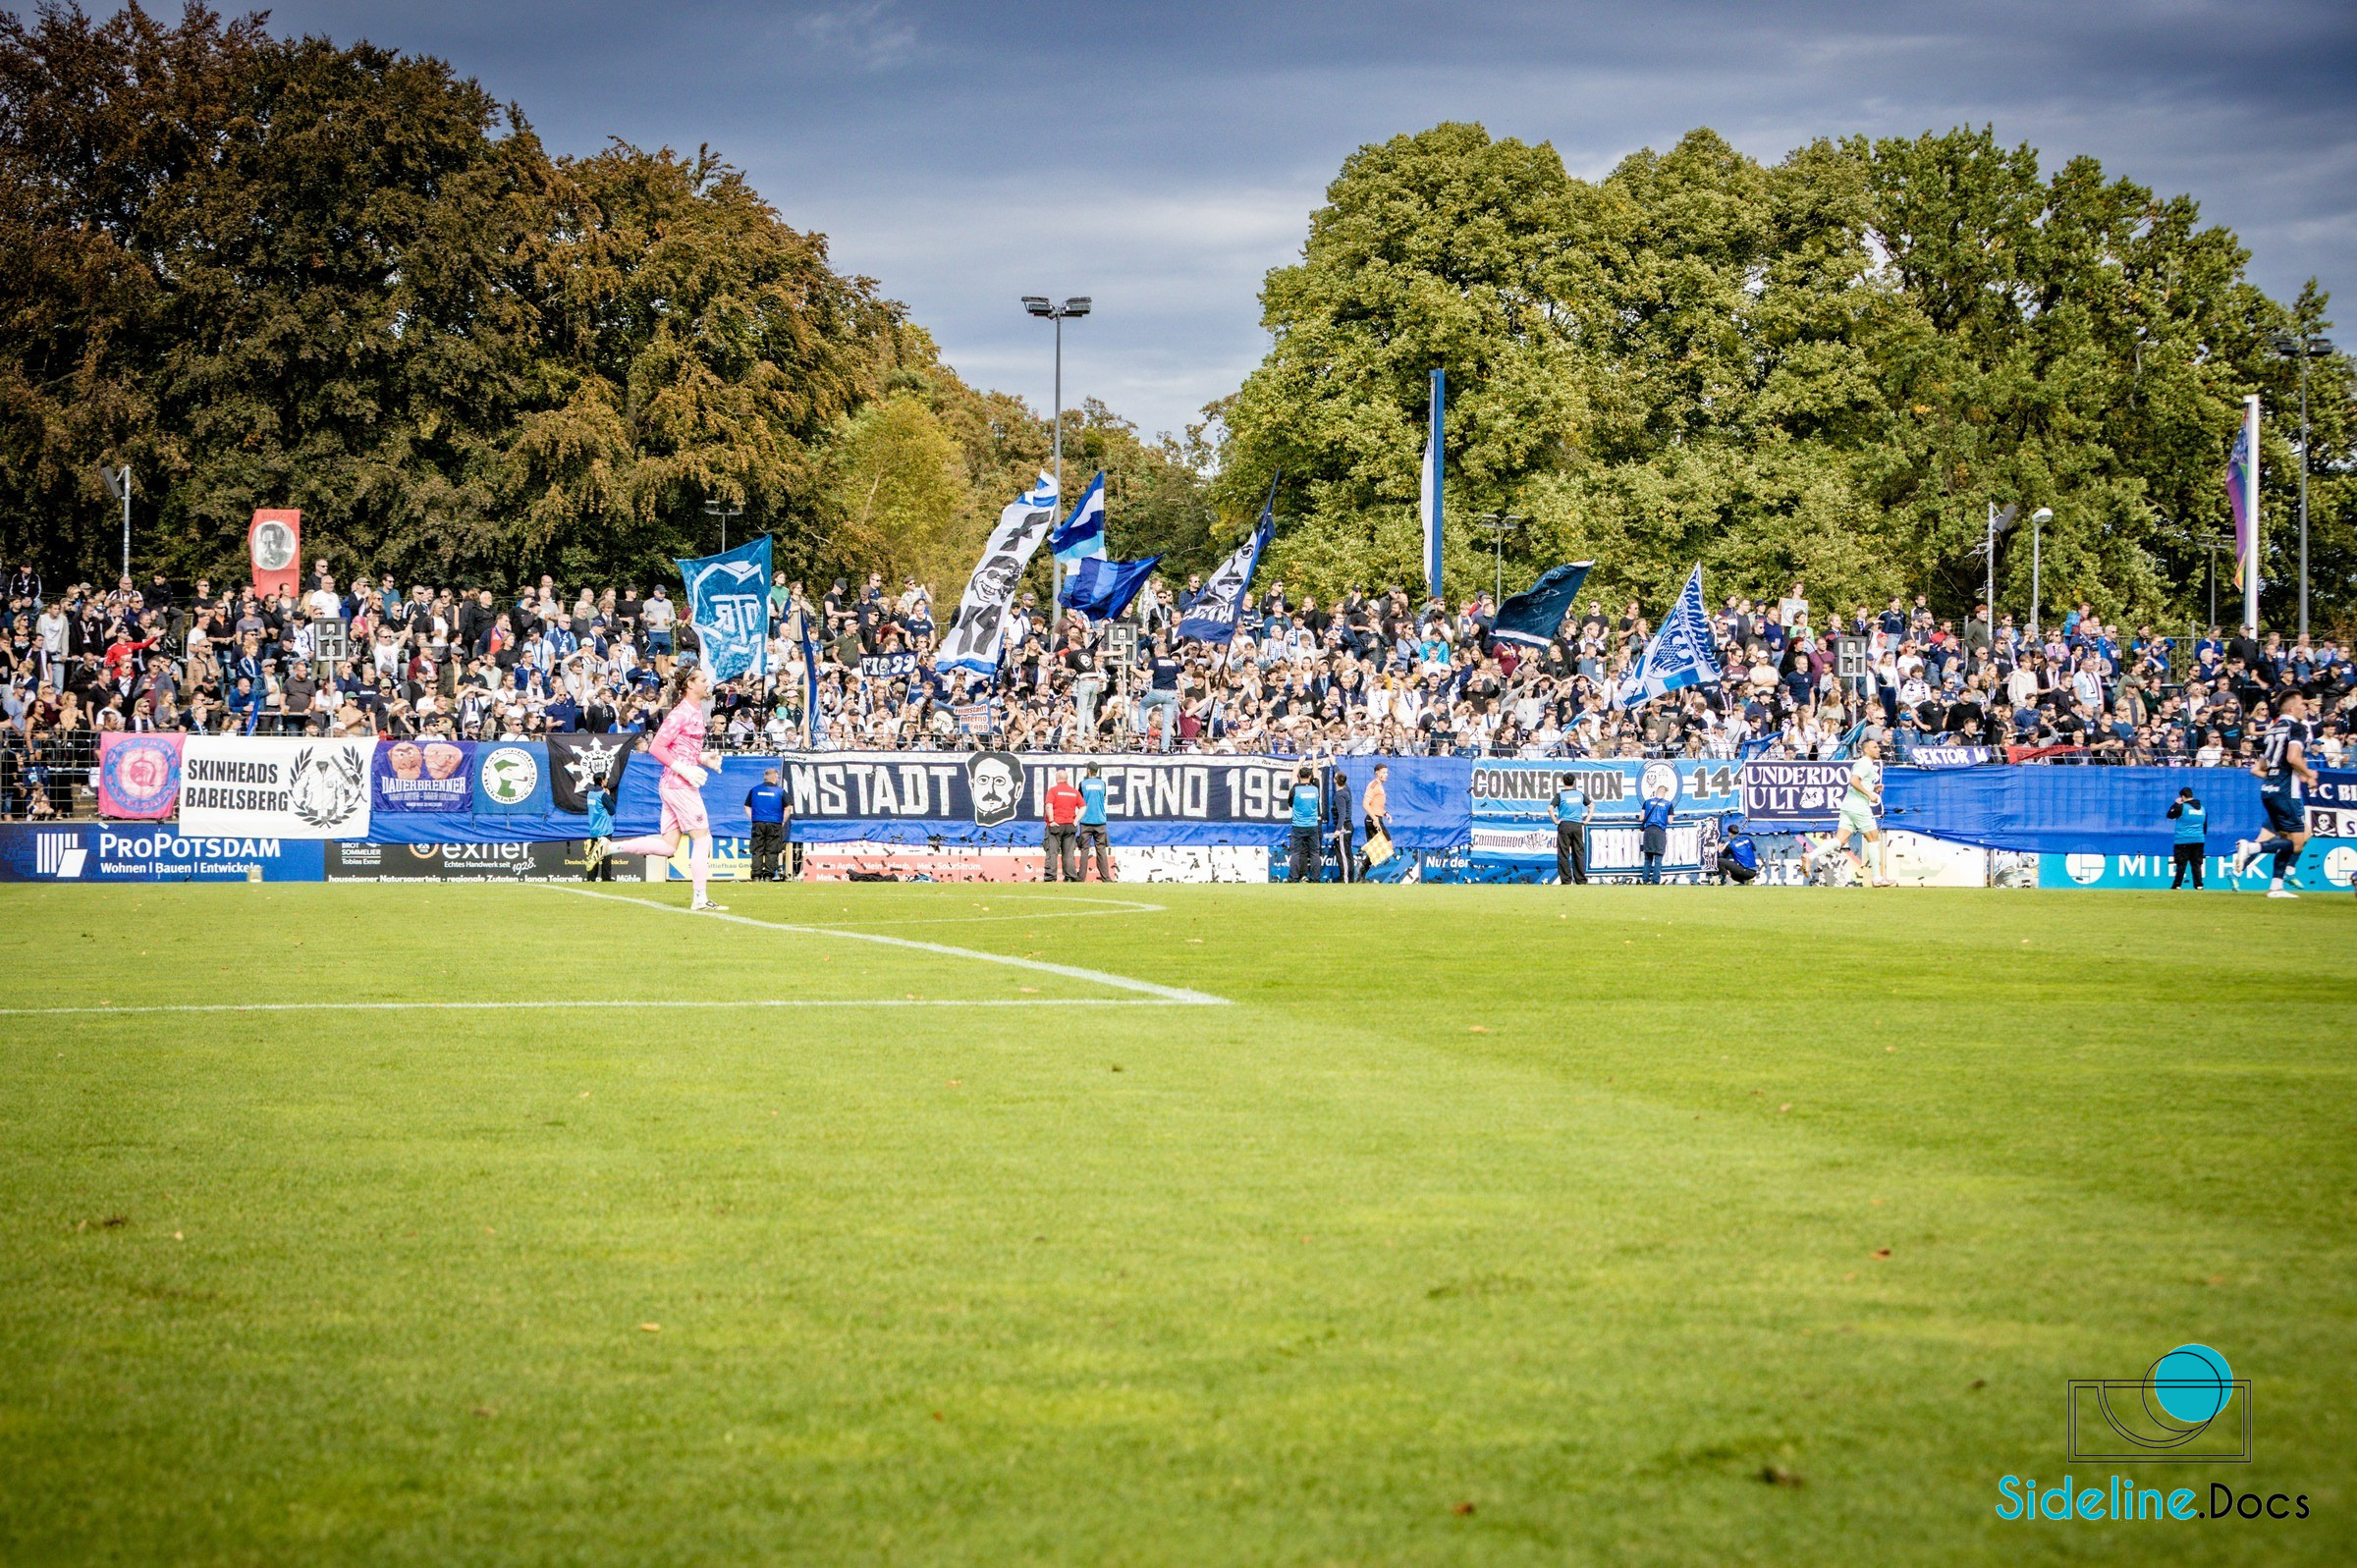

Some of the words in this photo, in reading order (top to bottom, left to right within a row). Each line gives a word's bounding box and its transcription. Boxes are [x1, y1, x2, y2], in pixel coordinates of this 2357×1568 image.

[1911, 747, 1970, 765] SEKTOR
[188, 758, 278, 784] SKINHEADS
[381, 775, 466, 794] DAUERBRENNER
[185, 786, 289, 812] BABELSBERG
[442, 841, 533, 859] exner
[100, 862, 146, 874] Wohnen
[155, 862, 192, 874] Bauen
[1426, 856, 1448, 868] Nur
[1450, 856, 1471, 868] der
[487, 874, 519, 883] Zutaten
